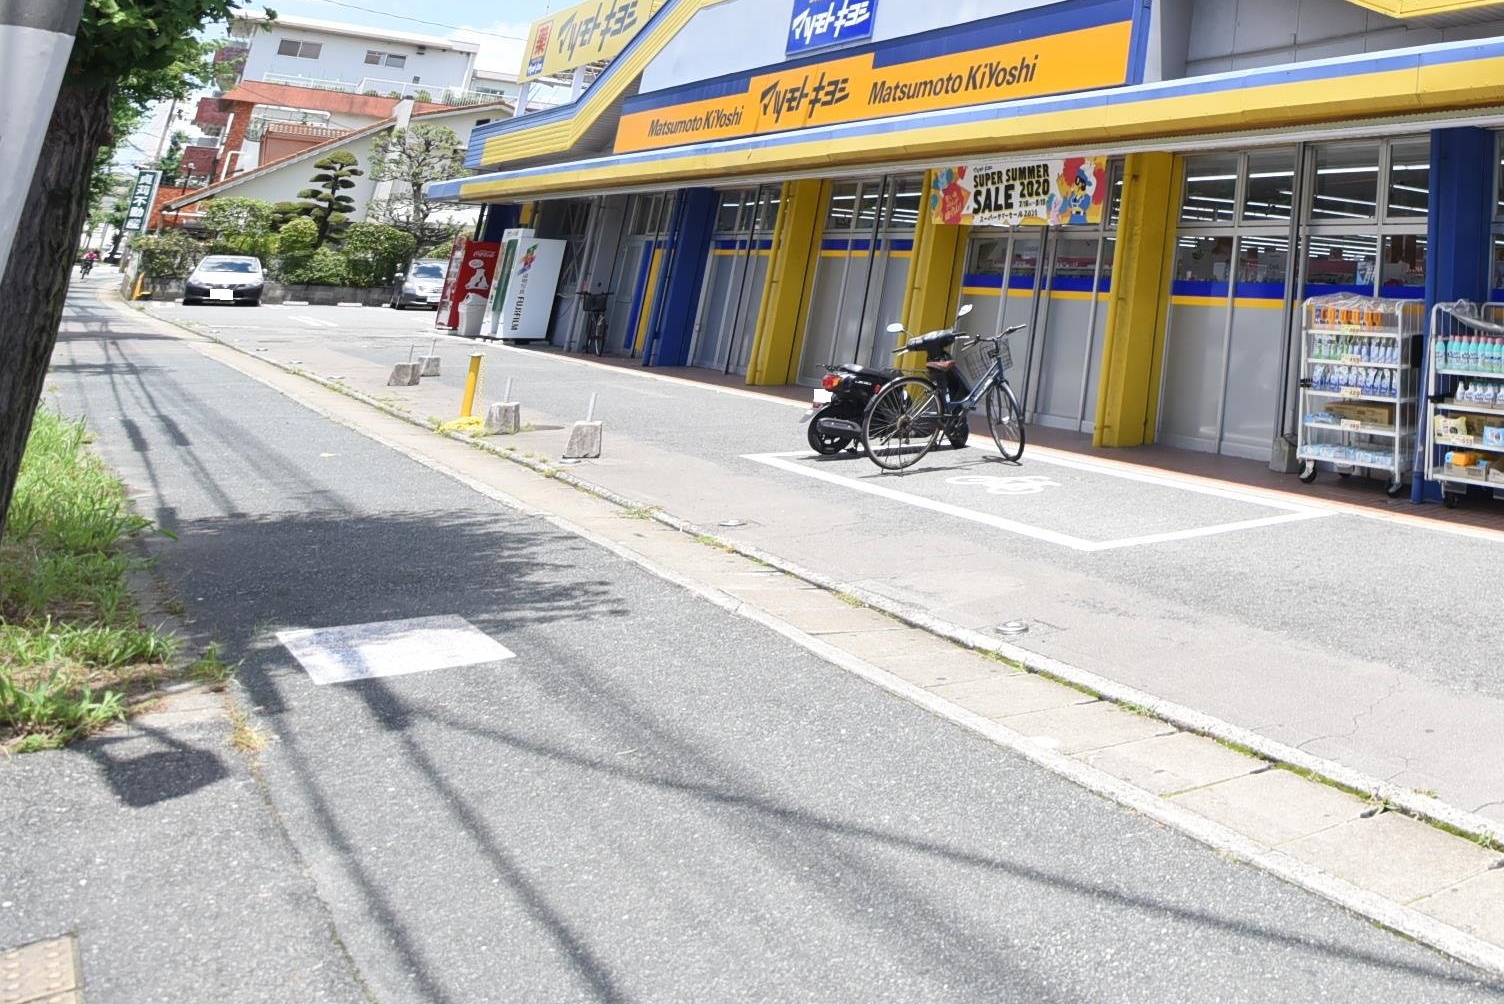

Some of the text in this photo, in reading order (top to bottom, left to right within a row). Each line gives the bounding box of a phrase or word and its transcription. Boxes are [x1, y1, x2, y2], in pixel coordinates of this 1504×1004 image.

[758, 71, 850, 124] マツモトキヨシ
[867, 54, 1040, 107] Matsumoto KiYoshi
[647, 105, 745, 139] Matsumoto KiYoshi
[973, 170, 1004, 188] SUPER
[1005, 163, 1050, 183] SUMMER
[972, 183, 1015, 215] SALE
[1019, 178, 1050, 199] 2020
[510, 296, 526, 331] FUJIFILM
